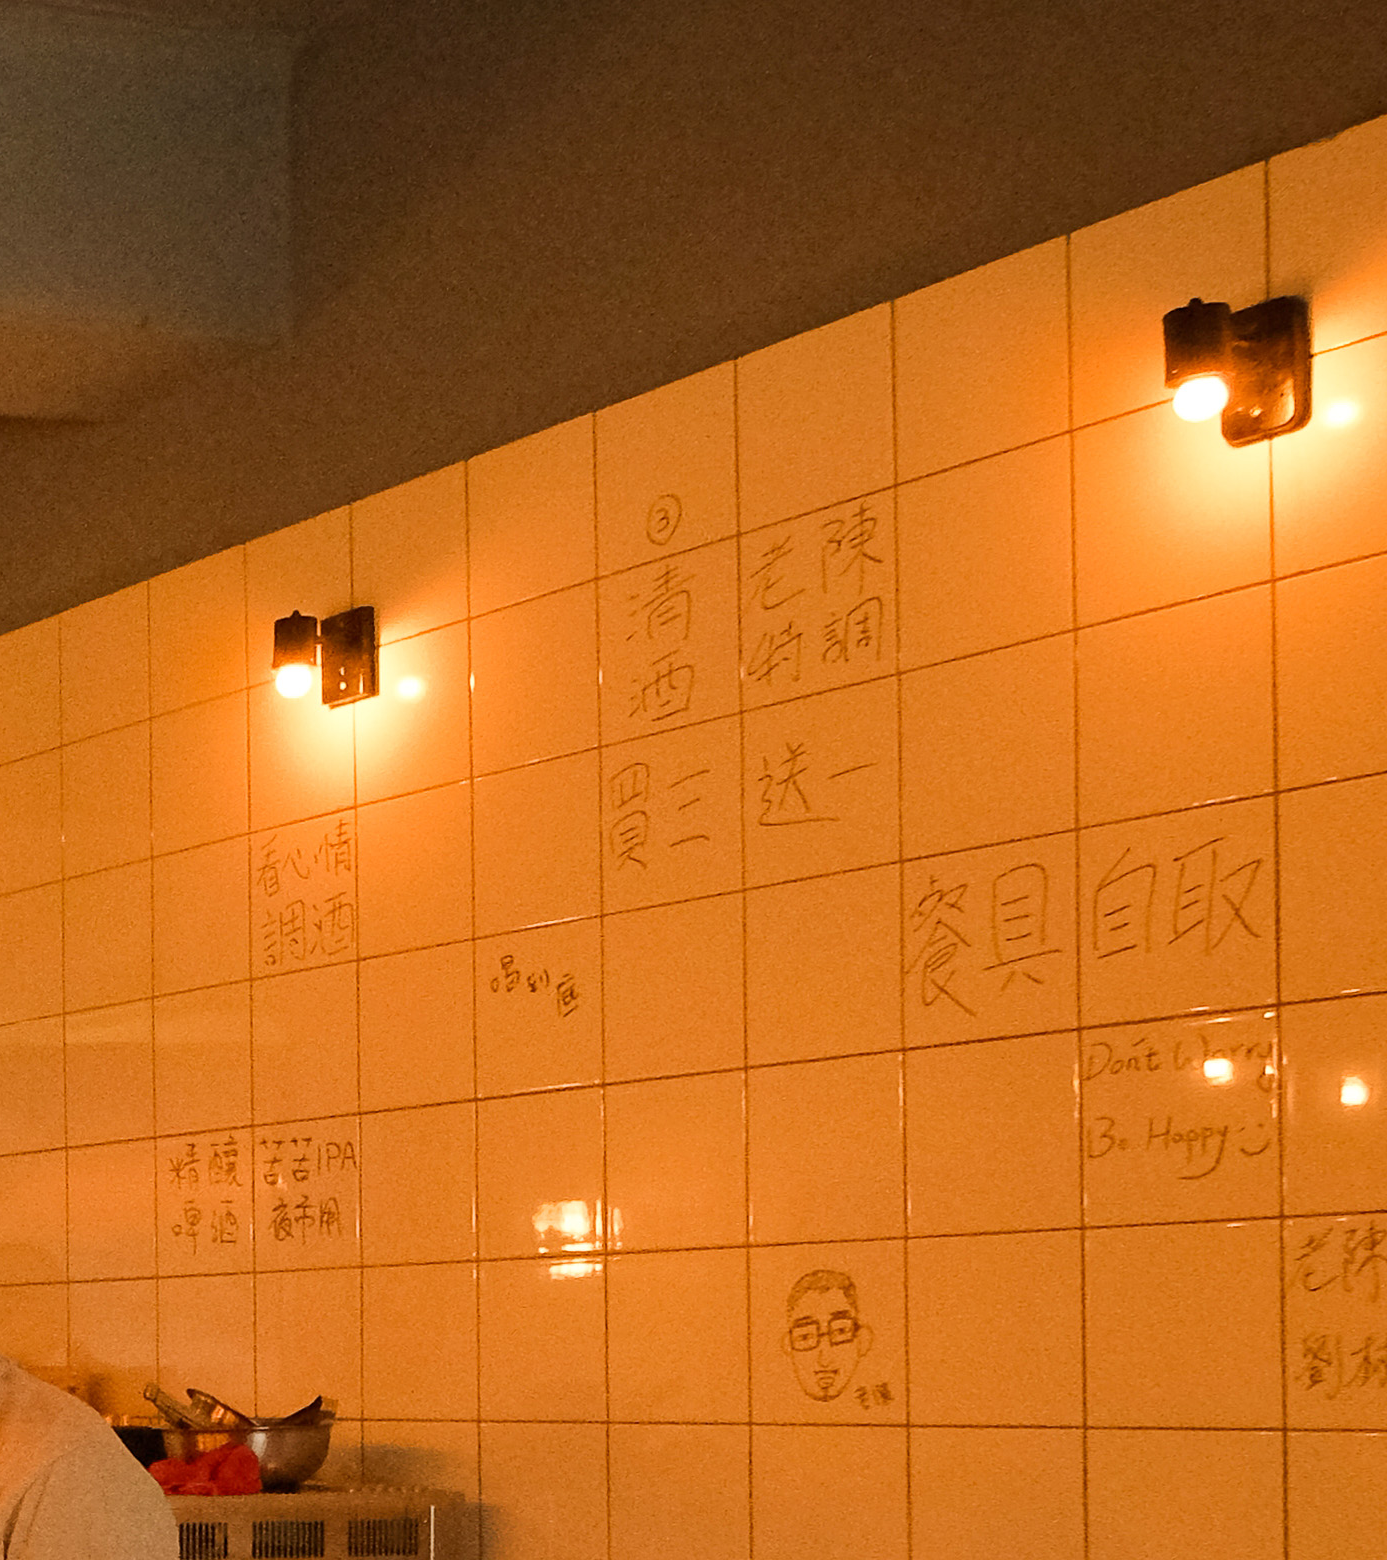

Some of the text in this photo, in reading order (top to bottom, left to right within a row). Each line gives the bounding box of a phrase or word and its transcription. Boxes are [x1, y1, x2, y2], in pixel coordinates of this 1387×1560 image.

[625, 563, 696, 722] 清酒
[608, 741, 878, 871] 買三送一
[902, 836, 1264, 1018] 餐具自取
